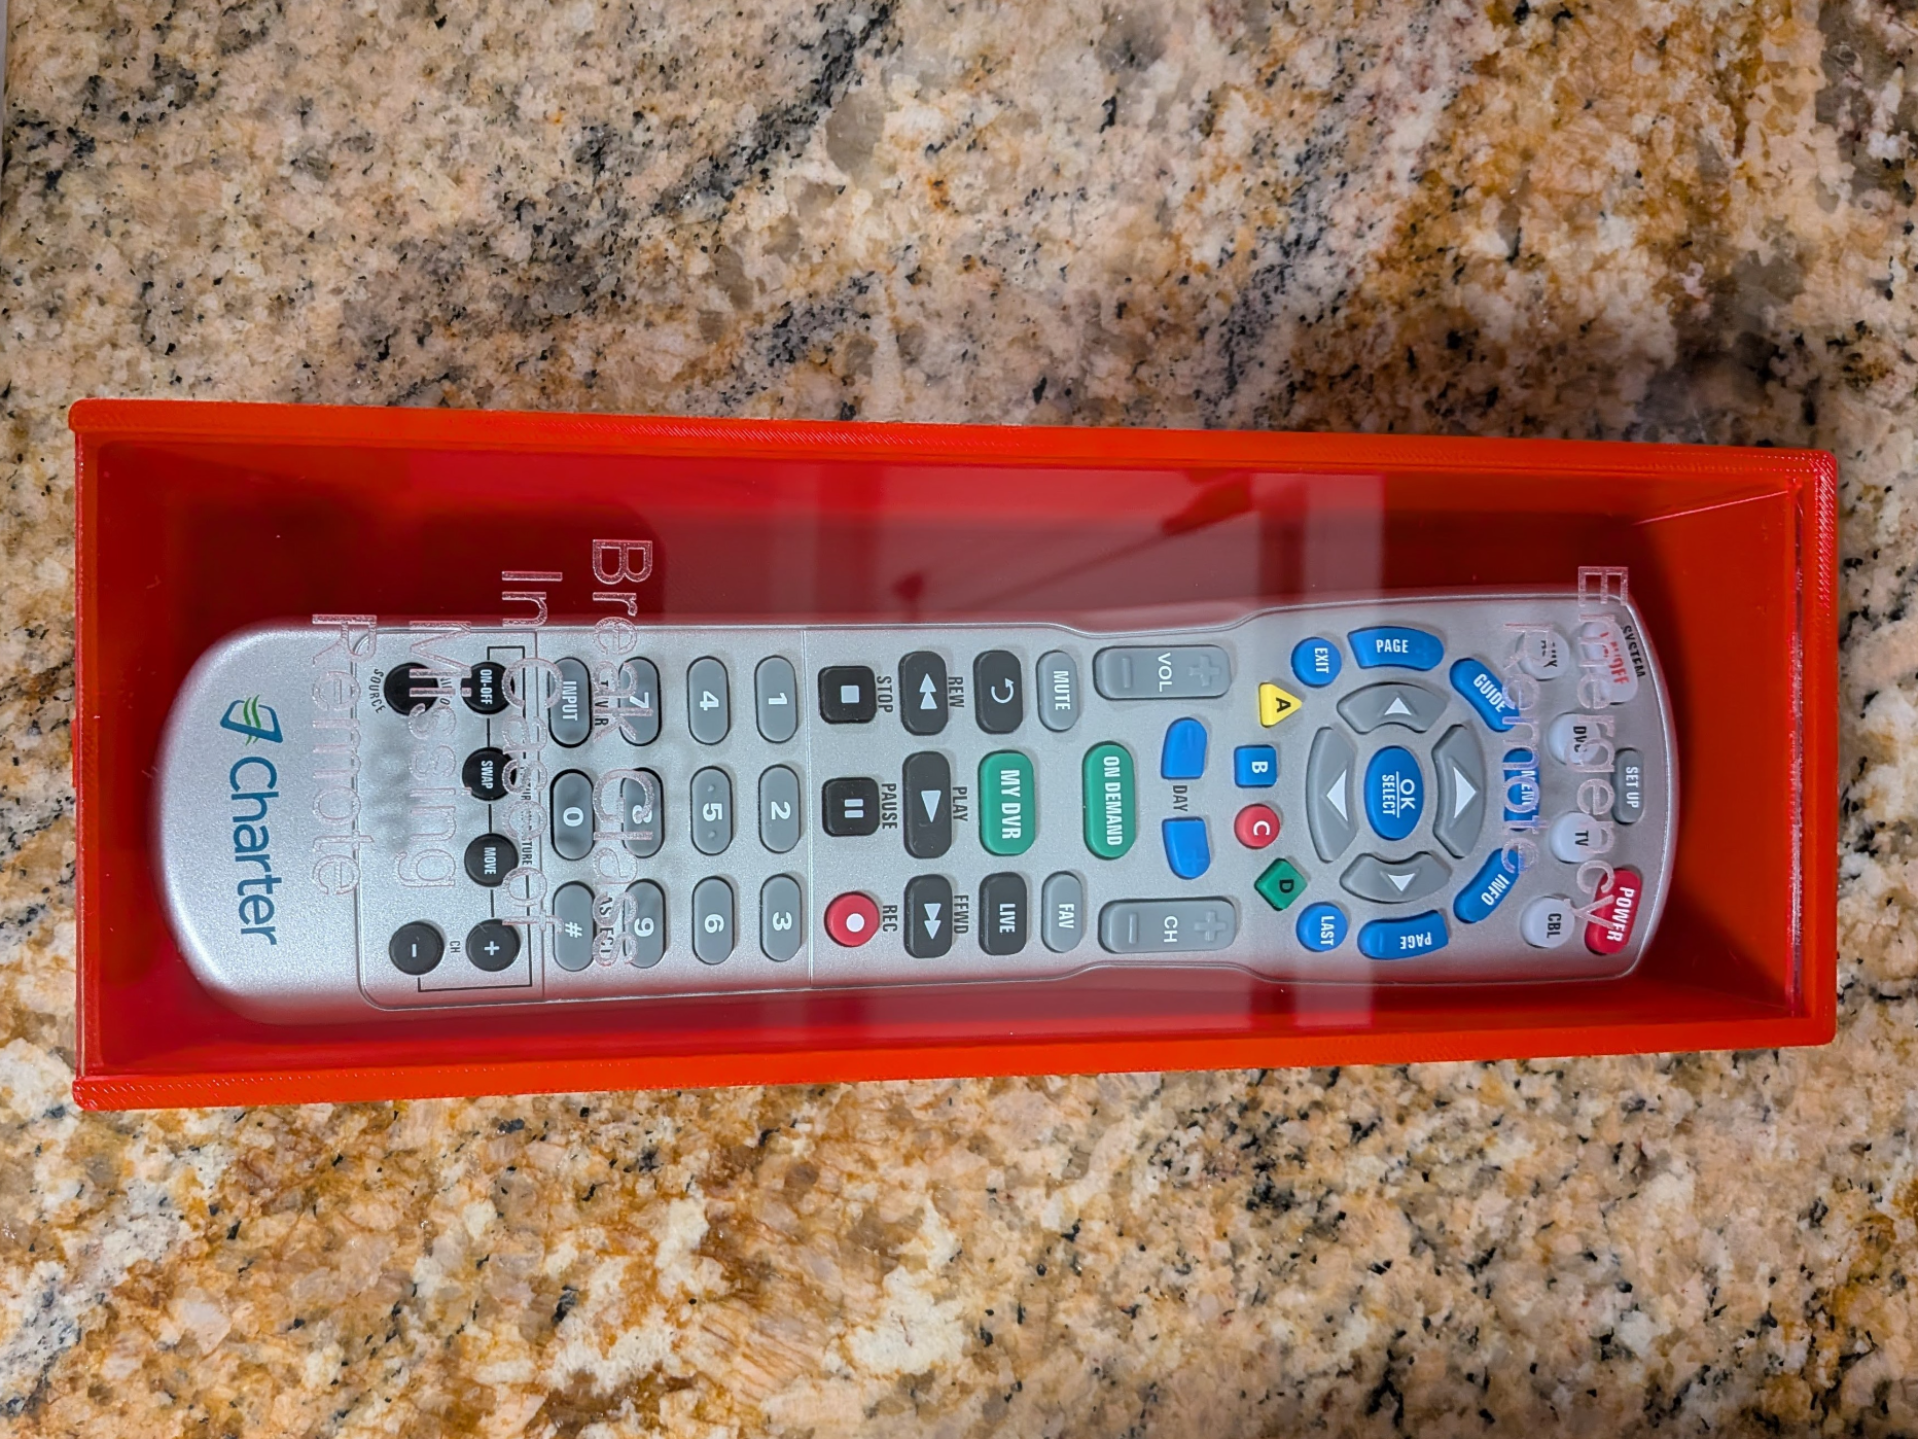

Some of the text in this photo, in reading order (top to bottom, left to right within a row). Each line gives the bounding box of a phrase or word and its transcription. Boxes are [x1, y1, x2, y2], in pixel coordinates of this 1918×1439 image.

[1314, 646, 1330, 674] EXIT
[1375, 638, 1409, 654] PAGE
[1621, 624, 1647, 678] SYSTEM
[479, 669, 493, 704] ON-OFF
[1157, 652, 1172, 692] VOL
[368, 668, 386, 714] SOURCE
[562, 680, 578, 721] INPUT
[629, 692, 650, 709] 7
[699, 690, 720, 711] 4
[768, 692, 788, 706] 1
[876, 675, 893, 714] STOP
[948, 676, 965, 708] REW
[1053, 670, 1071, 711] MUTE
[1276, 697, 1291, 713] A
[1472, 673, 1507, 713] GUIDE
[312, 613, 378, 896] Remote
[394, 620, 472, 888] Missing
[501, 570, 564, 934] In Case of
[592, 539, 655, 968] Break Glass
[1502, 623, 1553, 874] Remote
[1563, 566, 1629, 930] Emergency
[480, 760, 493, 789] SWAP
[1251, 760, 1268, 774] B
[1103, 756, 1123, 846] ON DEMAND
[1172, 784, 1188, 812] DAY
[1381, 774, 1396, 816] SELECT
[1400, 778, 1415, 810] OK
[1625, 766, 1640, 808] SET UP
[702, 801, 723, 822] 5
[770, 801, 791, 821] 2
[881, 783, 898, 830] PAUSE
[952, 786, 968, 823] PLAY
[1000, 769, 1021, 840] MY DVR
[1252, 821, 1270, 836] C
[1575, 830, 1589, 846] TV
[228, 755, 284, 946] Charter
[483, 846, 497, 875] MOVE
[1279, 878, 1295, 892] D
[1481, 873, 1510, 906] INFO
[633, 917, 655, 937] 9
[704, 913, 725, 934] 6
[772, 911, 792, 931] 3
[882, 904, 898, 932] REC
[953, 894, 970, 935] FFWD
[999, 903, 1016, 934] LIVE
[1058, 903, 1075, 930] FAV
[1163, 915, 1178, 943] CH
[1547, 913, 1562, 938] CBL
[1606, 886, 1635, 942] POWER
[564, 921, 583, 939] #
[1320, 915, 1335, 946] LAST
[1399, 931, 1432, 949] PAGE
[449, 940, 461, 953] CH
